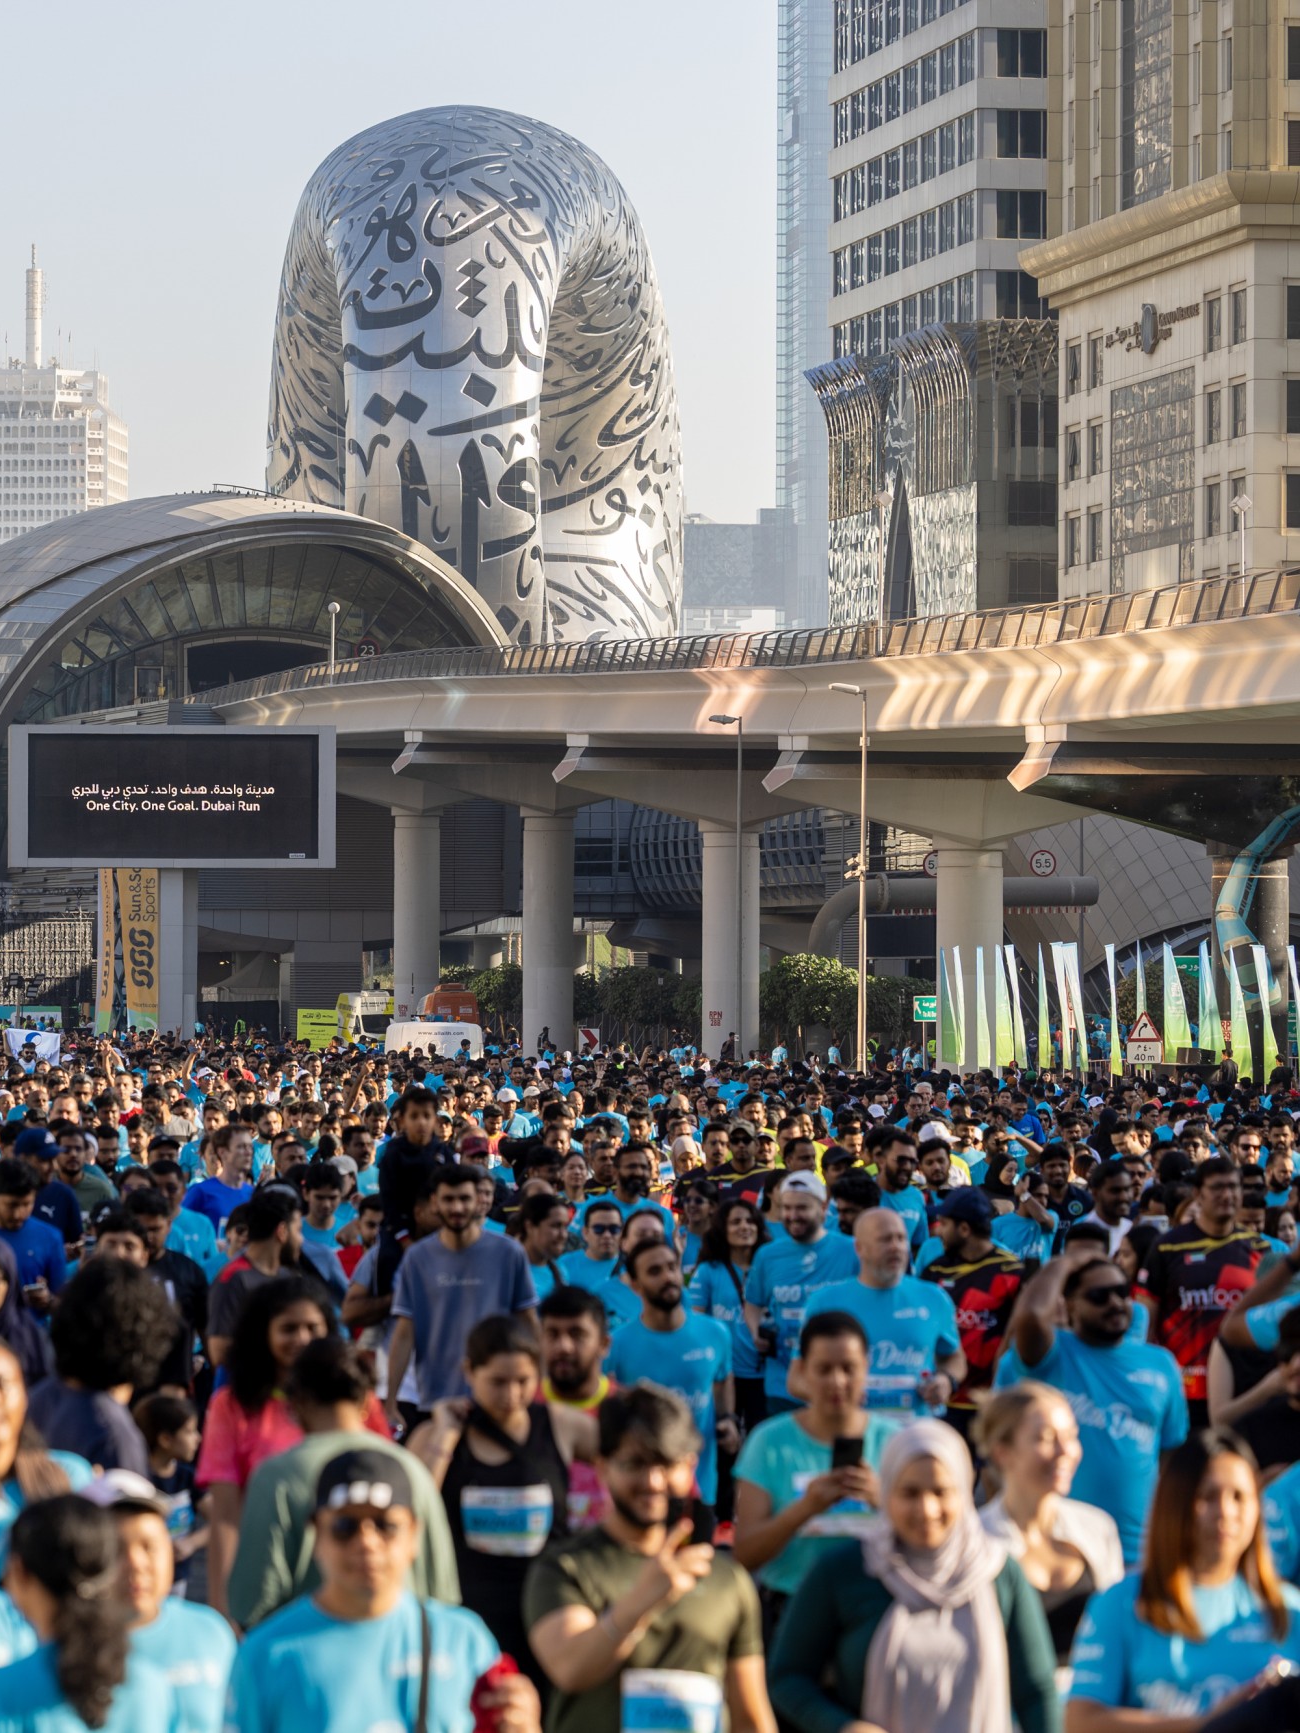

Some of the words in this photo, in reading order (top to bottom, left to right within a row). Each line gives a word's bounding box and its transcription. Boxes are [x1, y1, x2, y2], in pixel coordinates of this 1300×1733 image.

[360, 645, 375, 656] 23
[71, 783, 100, 799] للجري
[101, 785, 120, 799] دبي
[122, 784, 150, 799] تحدي
[151, 784, 178, 797] واحد.
[180, 784, 207, 795] هدف
[211, 783, 243, 798] واحدة.
[245, 783, 275, 798] مدينة
[86, 801, 111, 811] One
[112, 801, 139, 814] City.
[141, 801, 166, 811] One
[167, 801, 199, 811] Goal.
[201, 801, 236, 811] Dubai
[238, 801, 260, 811] Run
[928, 860, 937, 869] 5.
[1035, 859, 1051, 869] 5.5
[143, 877, 157, 922] Sports
[1134, 1053, 1146, 1061] 40
